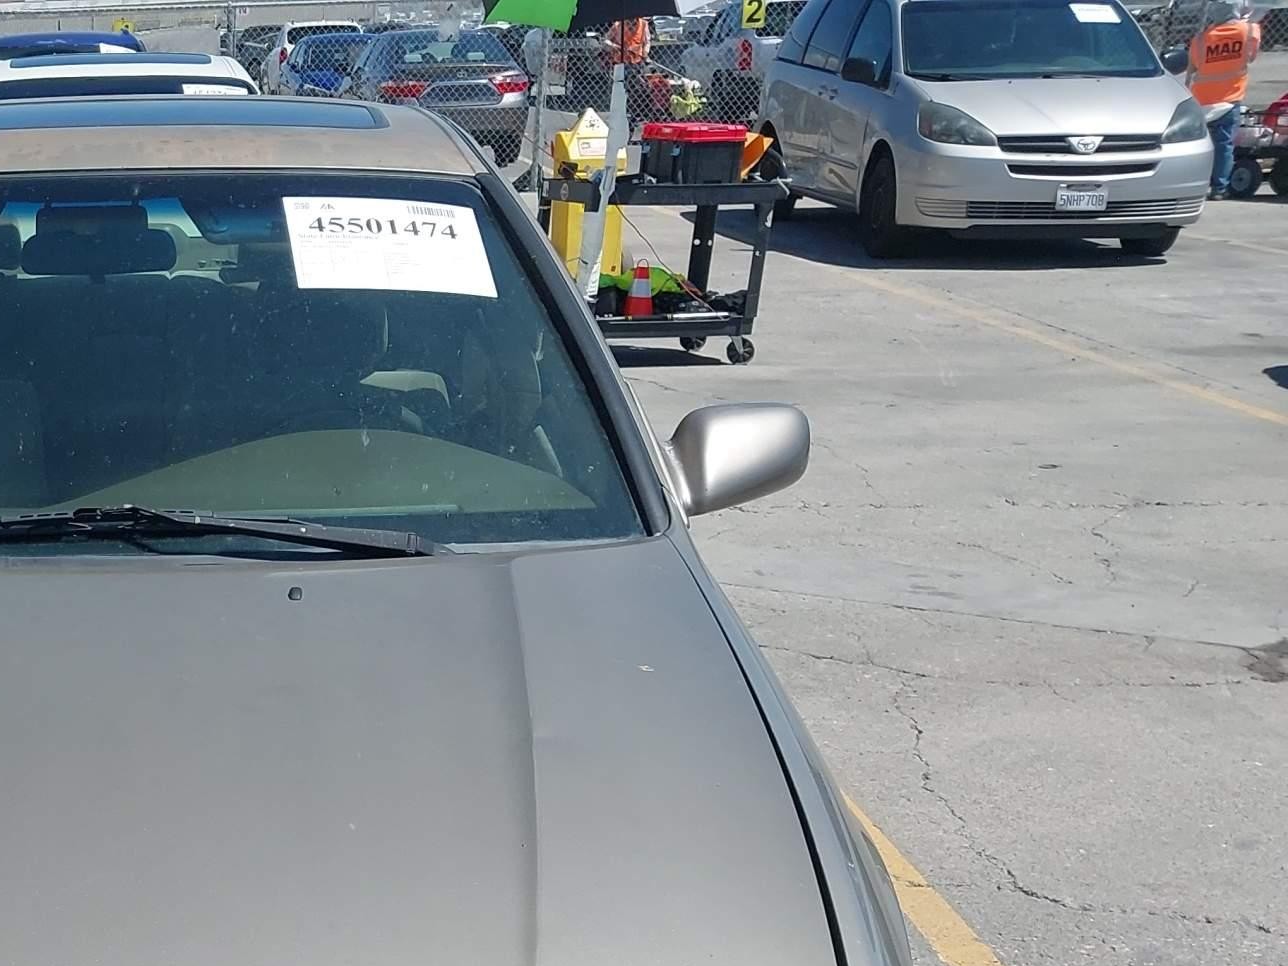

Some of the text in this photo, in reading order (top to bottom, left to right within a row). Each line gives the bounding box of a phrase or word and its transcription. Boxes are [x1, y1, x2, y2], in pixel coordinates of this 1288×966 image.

[746, 0, 763, 23] 2
[1206, 41, 1243, 58] MAD
[309, 217, 458, 240] 45501474
